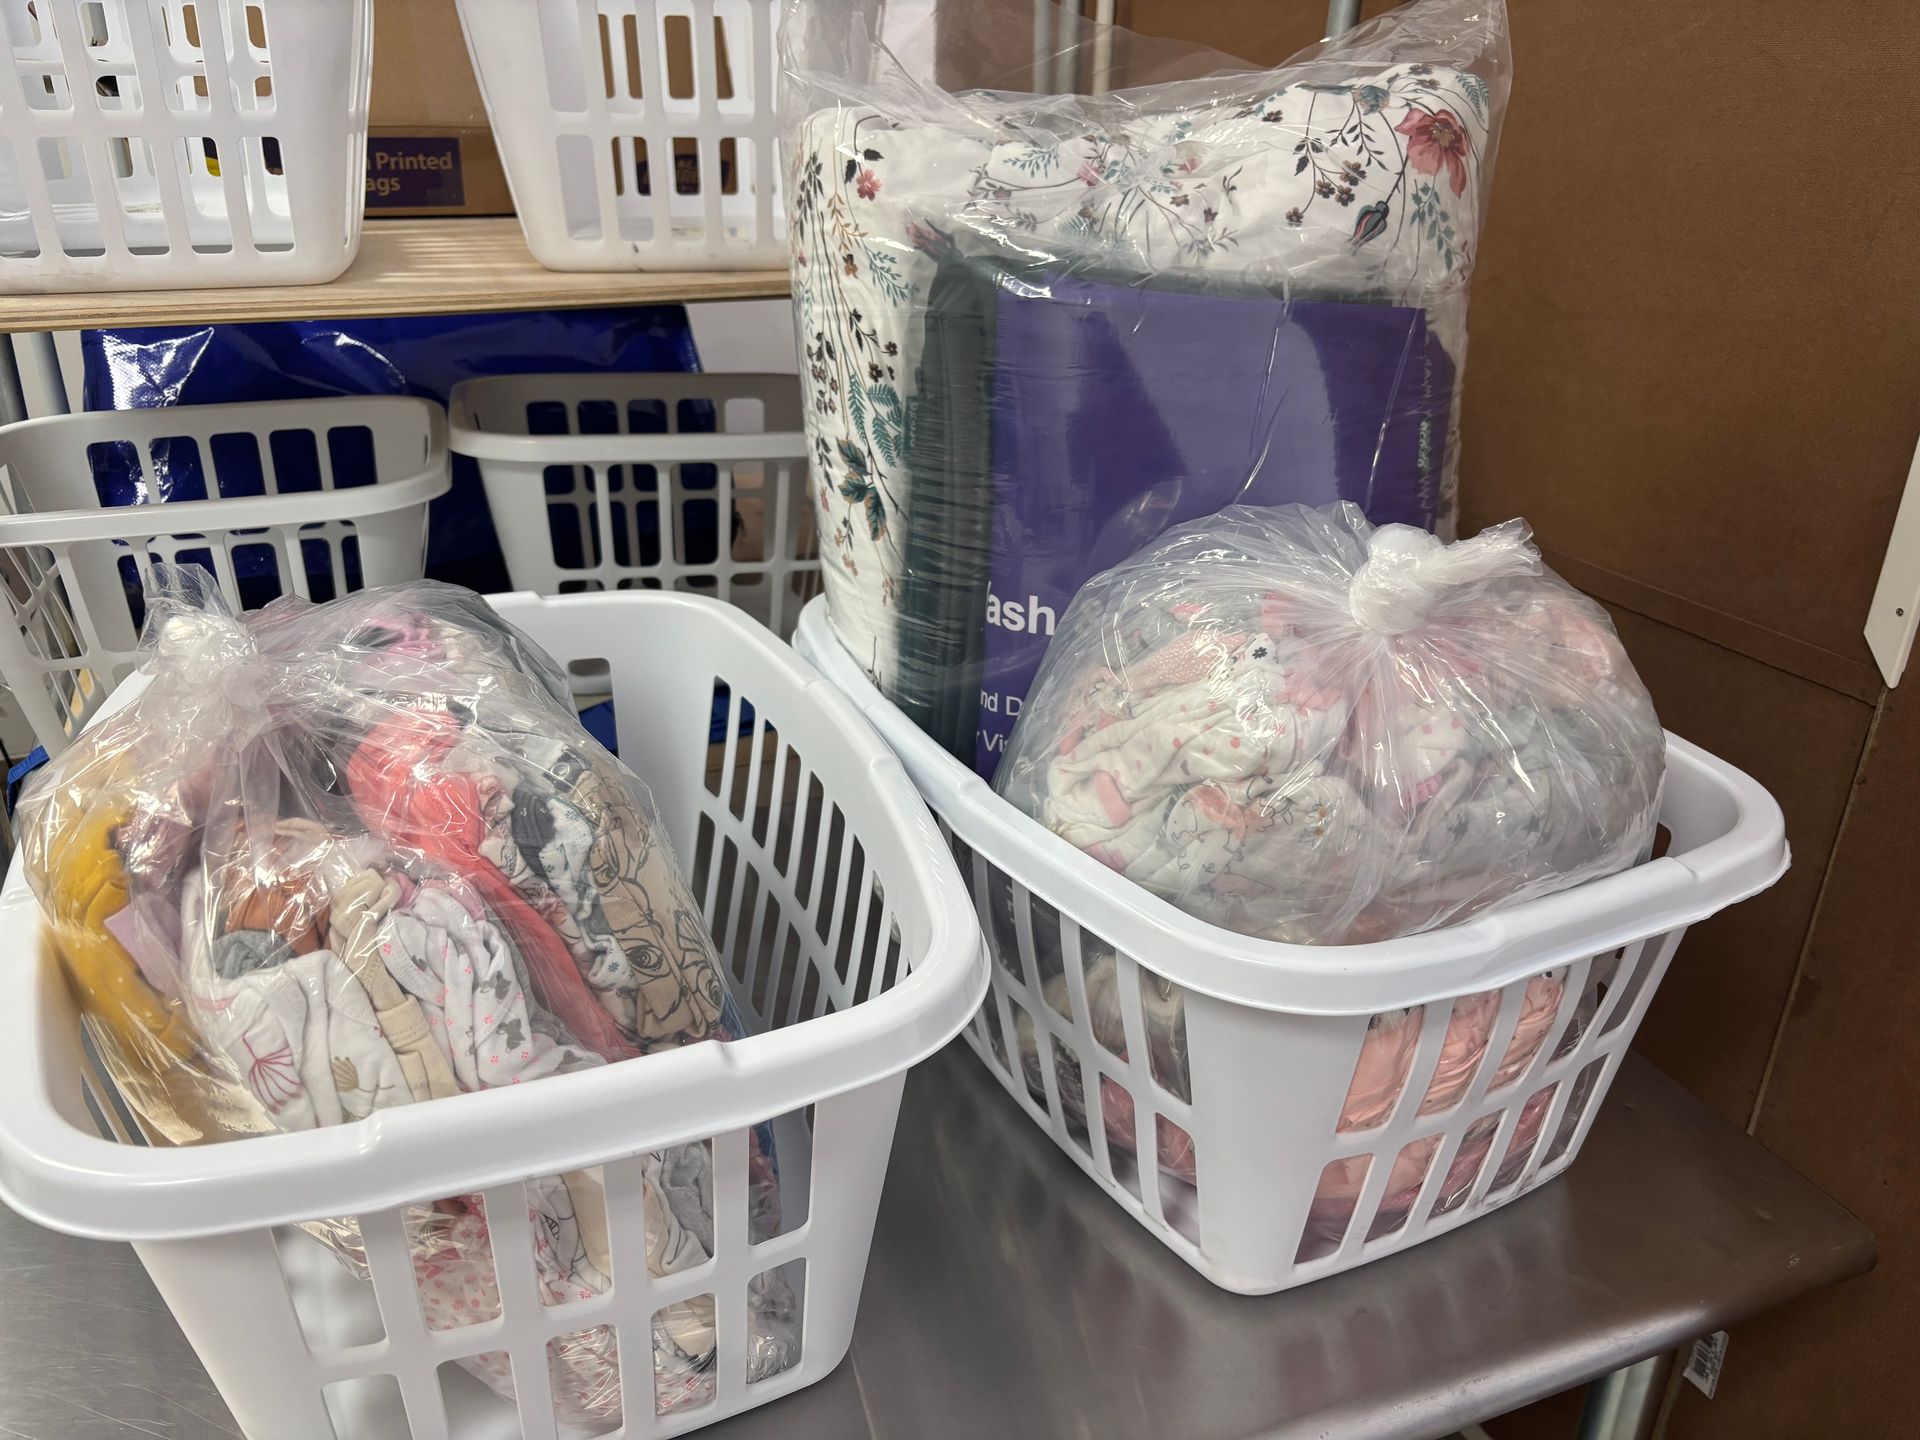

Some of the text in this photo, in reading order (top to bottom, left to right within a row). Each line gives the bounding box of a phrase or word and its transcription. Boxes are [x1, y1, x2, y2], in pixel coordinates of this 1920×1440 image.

[375, 151, 453, 170] Printed
[366, 177, 401, 196] ags
[986, 580, 1056, 636] ash
[980, 689, 998, 713] nd
